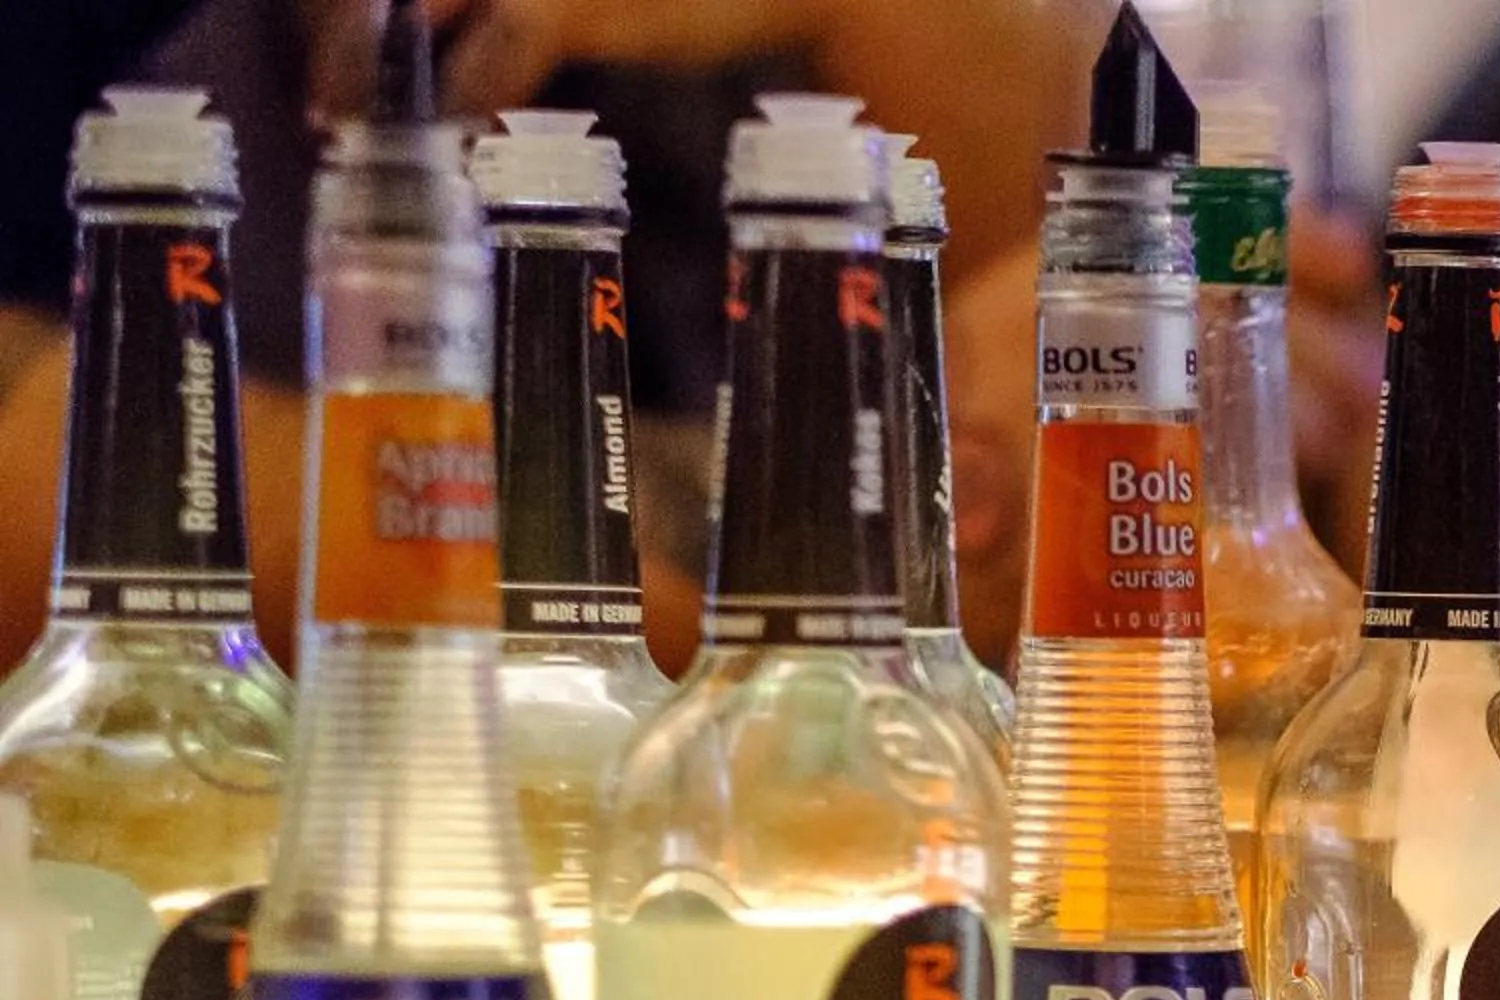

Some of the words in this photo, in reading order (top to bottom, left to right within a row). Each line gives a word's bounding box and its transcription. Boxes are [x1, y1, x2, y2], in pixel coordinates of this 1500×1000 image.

[1043, 346, 1137, 375] BOLS
[176, 337, 218, 533] Rohrzucker
[597, 395, 630, 514] Almond
[1109, 460, 1193, 503] Bols
[1110, 513, 1196, 557] Blue
[1447, 609, 1490, 629] MADE
